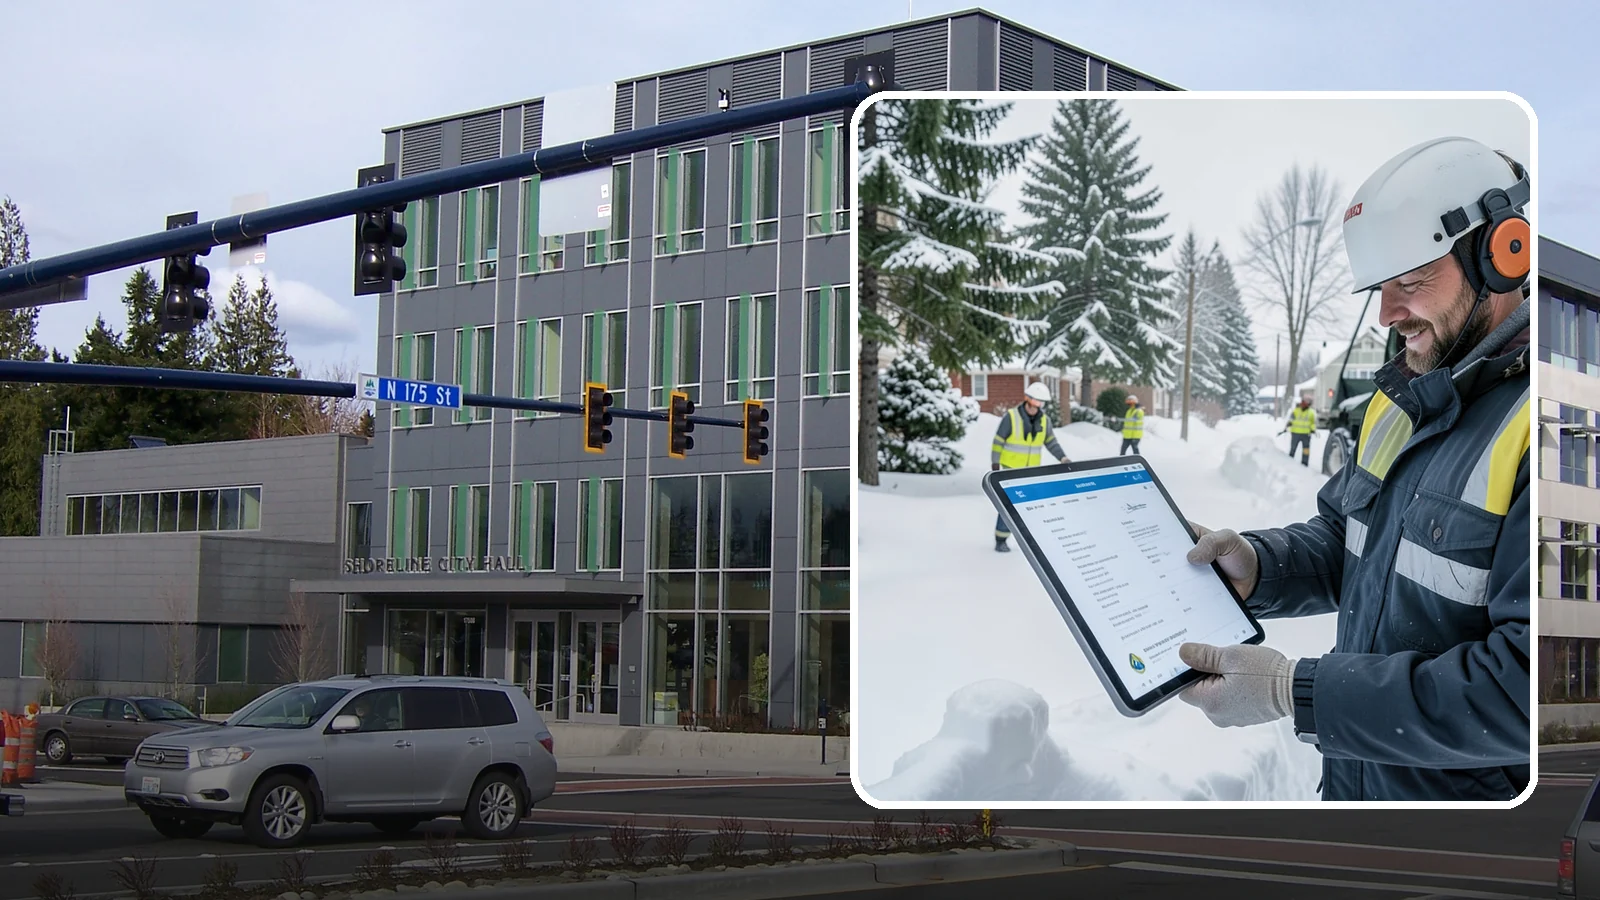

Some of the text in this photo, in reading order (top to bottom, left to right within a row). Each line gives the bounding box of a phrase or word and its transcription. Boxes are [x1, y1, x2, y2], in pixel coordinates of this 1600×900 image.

[387, 380, 451, 406] N 175 St
[344, 554, 526, 574] SHORELINE CITY HALL
